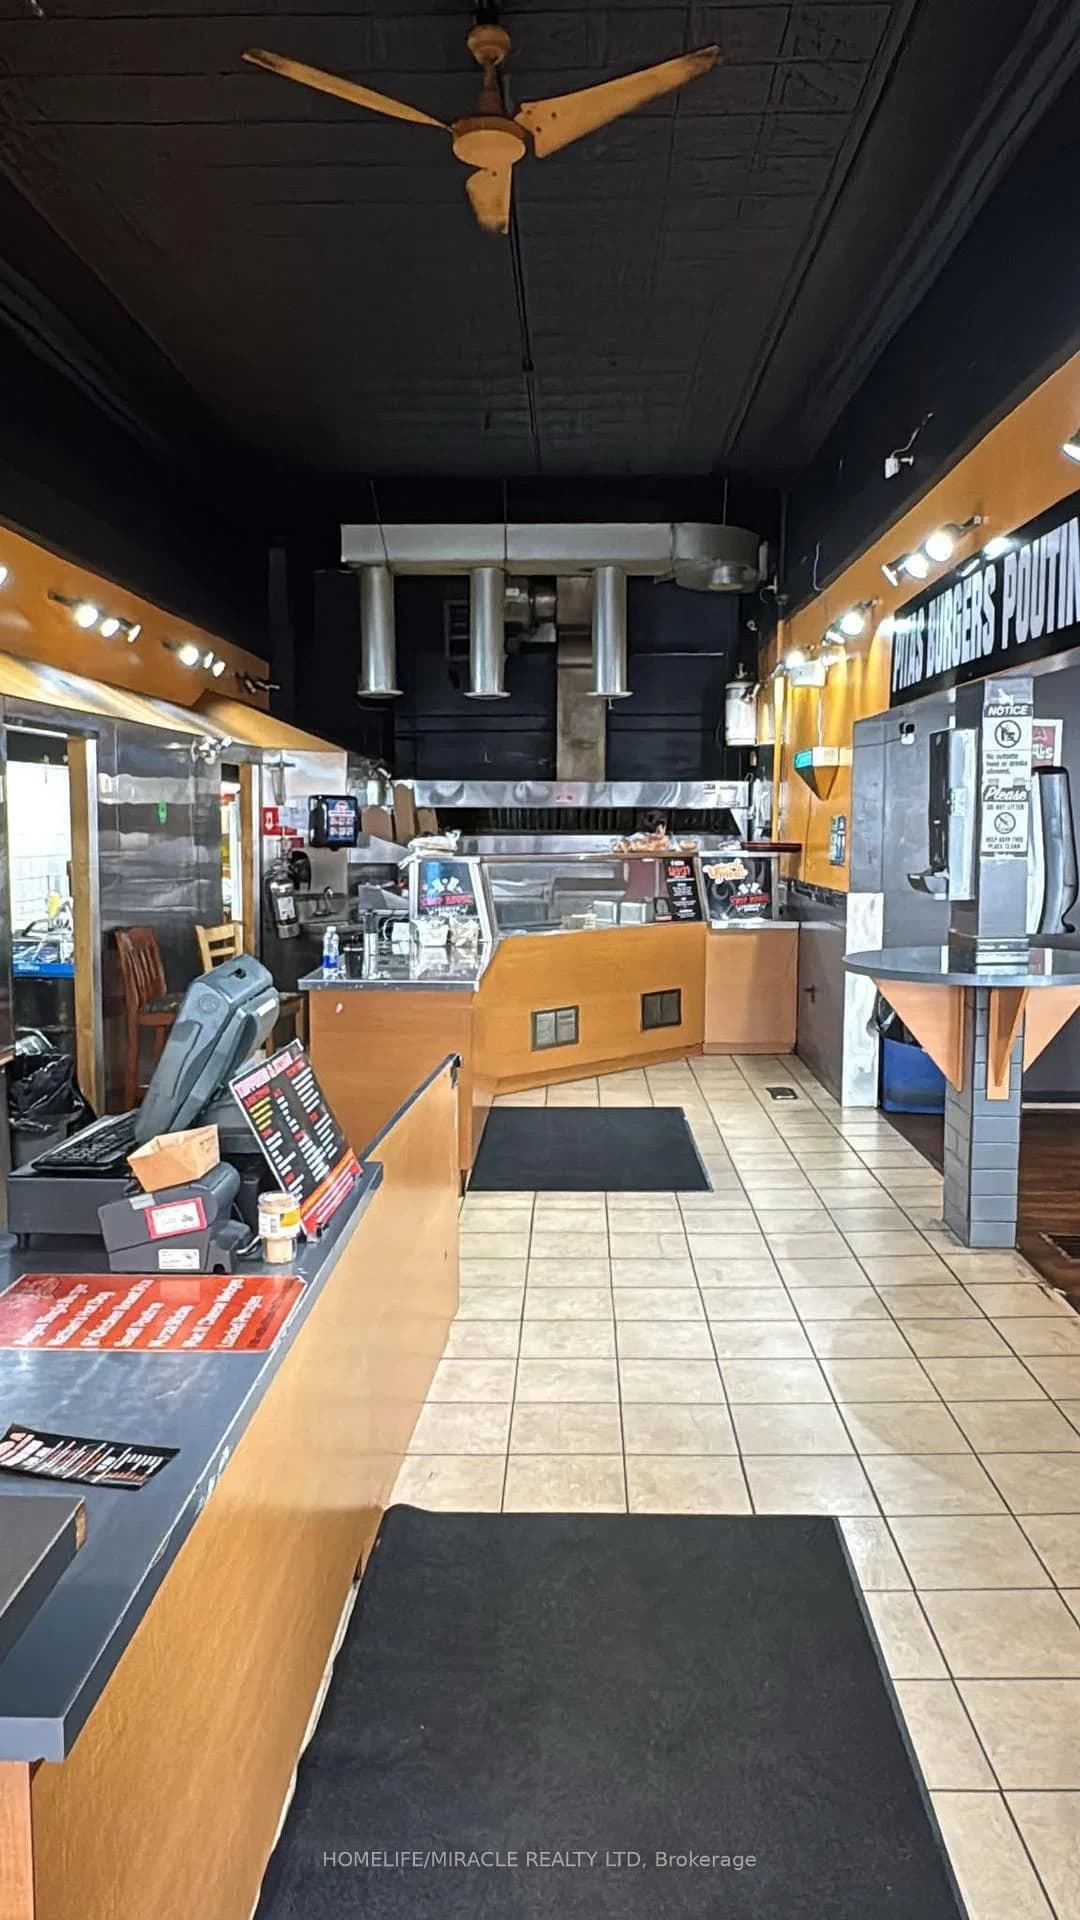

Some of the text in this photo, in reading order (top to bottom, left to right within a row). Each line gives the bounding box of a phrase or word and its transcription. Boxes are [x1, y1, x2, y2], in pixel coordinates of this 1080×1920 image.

[892, 606, 925, 693] PITAS
[926, 563, 997, 679] BURGERS
[988, 705, 1028, 716] NOTICE
[984, 786, 1027, 801] Please
